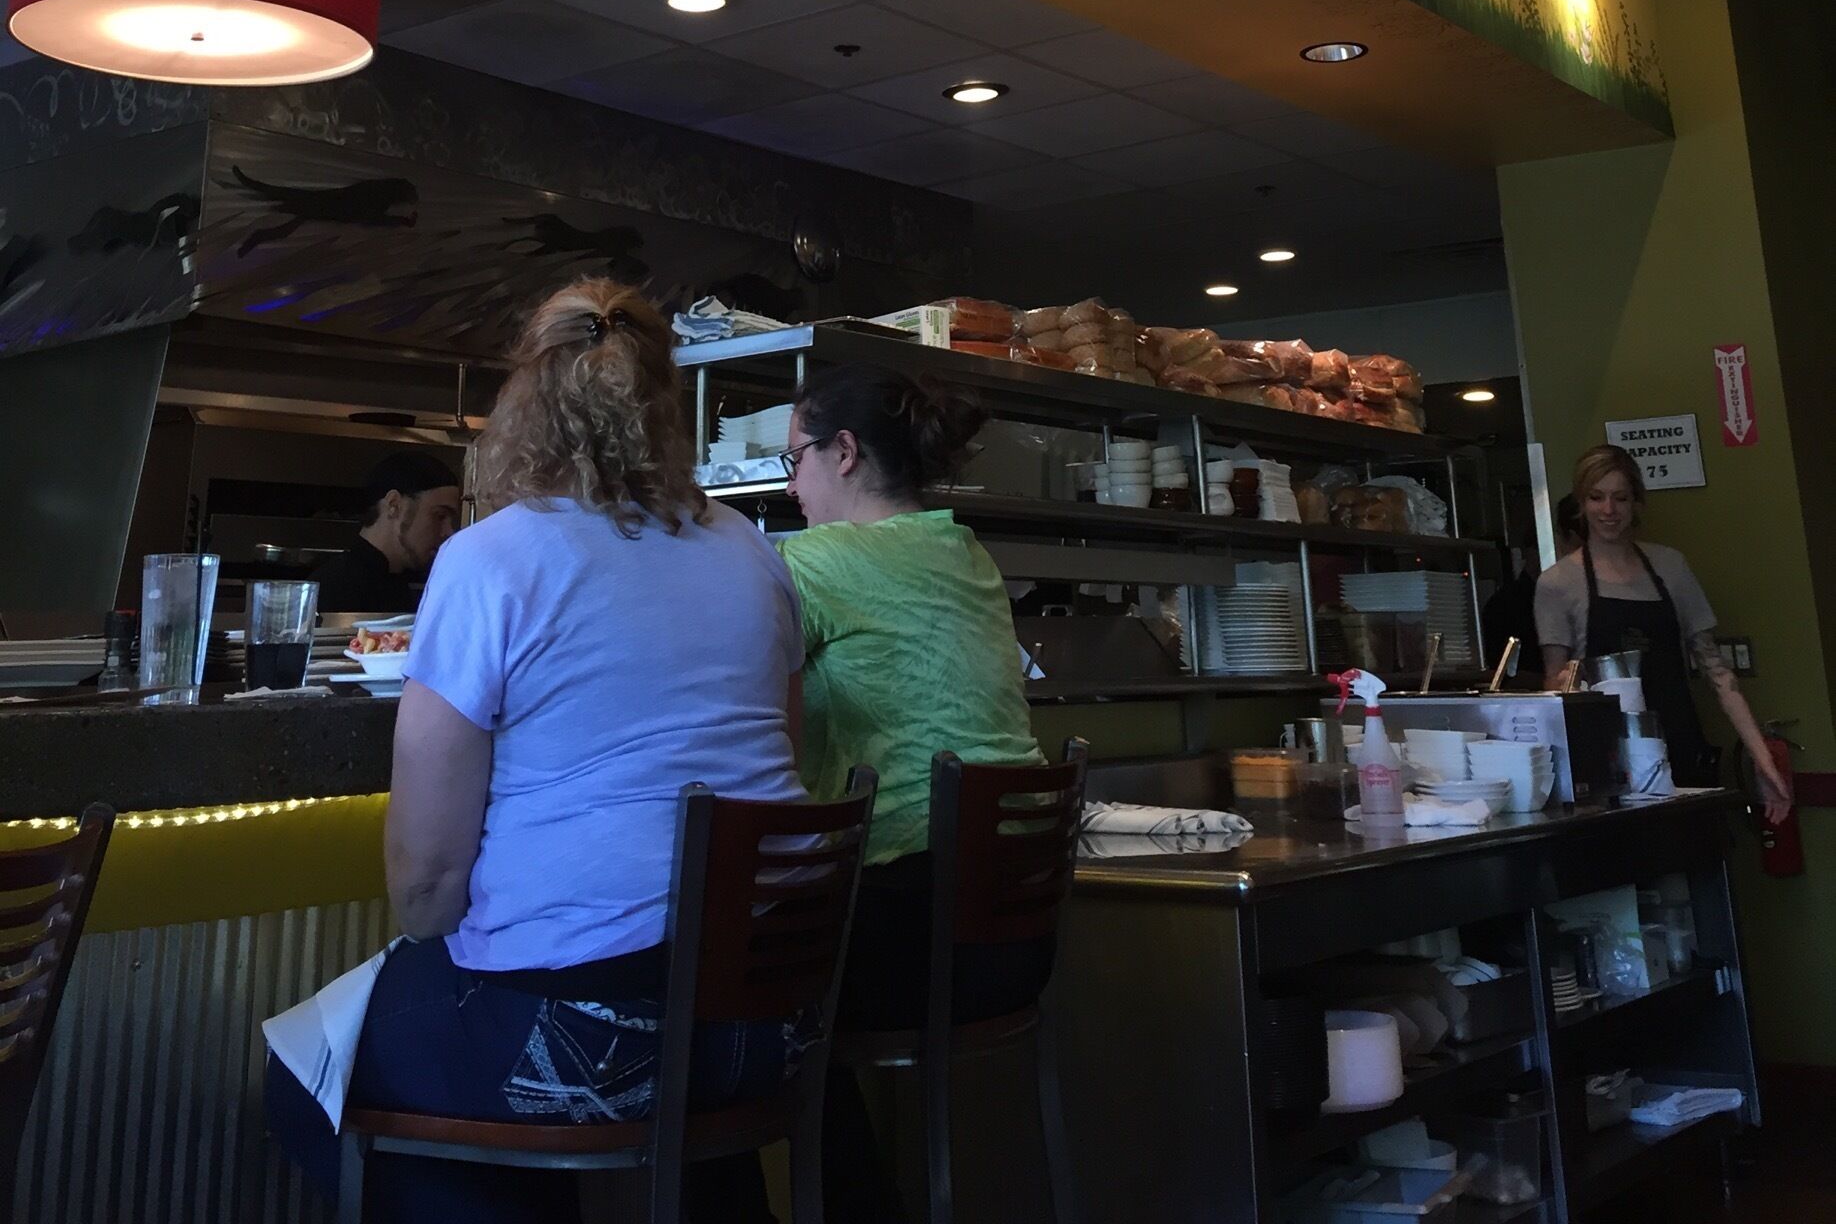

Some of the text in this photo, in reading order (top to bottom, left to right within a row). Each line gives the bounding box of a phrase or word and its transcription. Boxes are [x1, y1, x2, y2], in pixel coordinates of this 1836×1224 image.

[1717, 355, 1743, 365] FIRE
[1620, 426, 1684, 441] SEATING
[1646, 464, 1669, 478] 75
